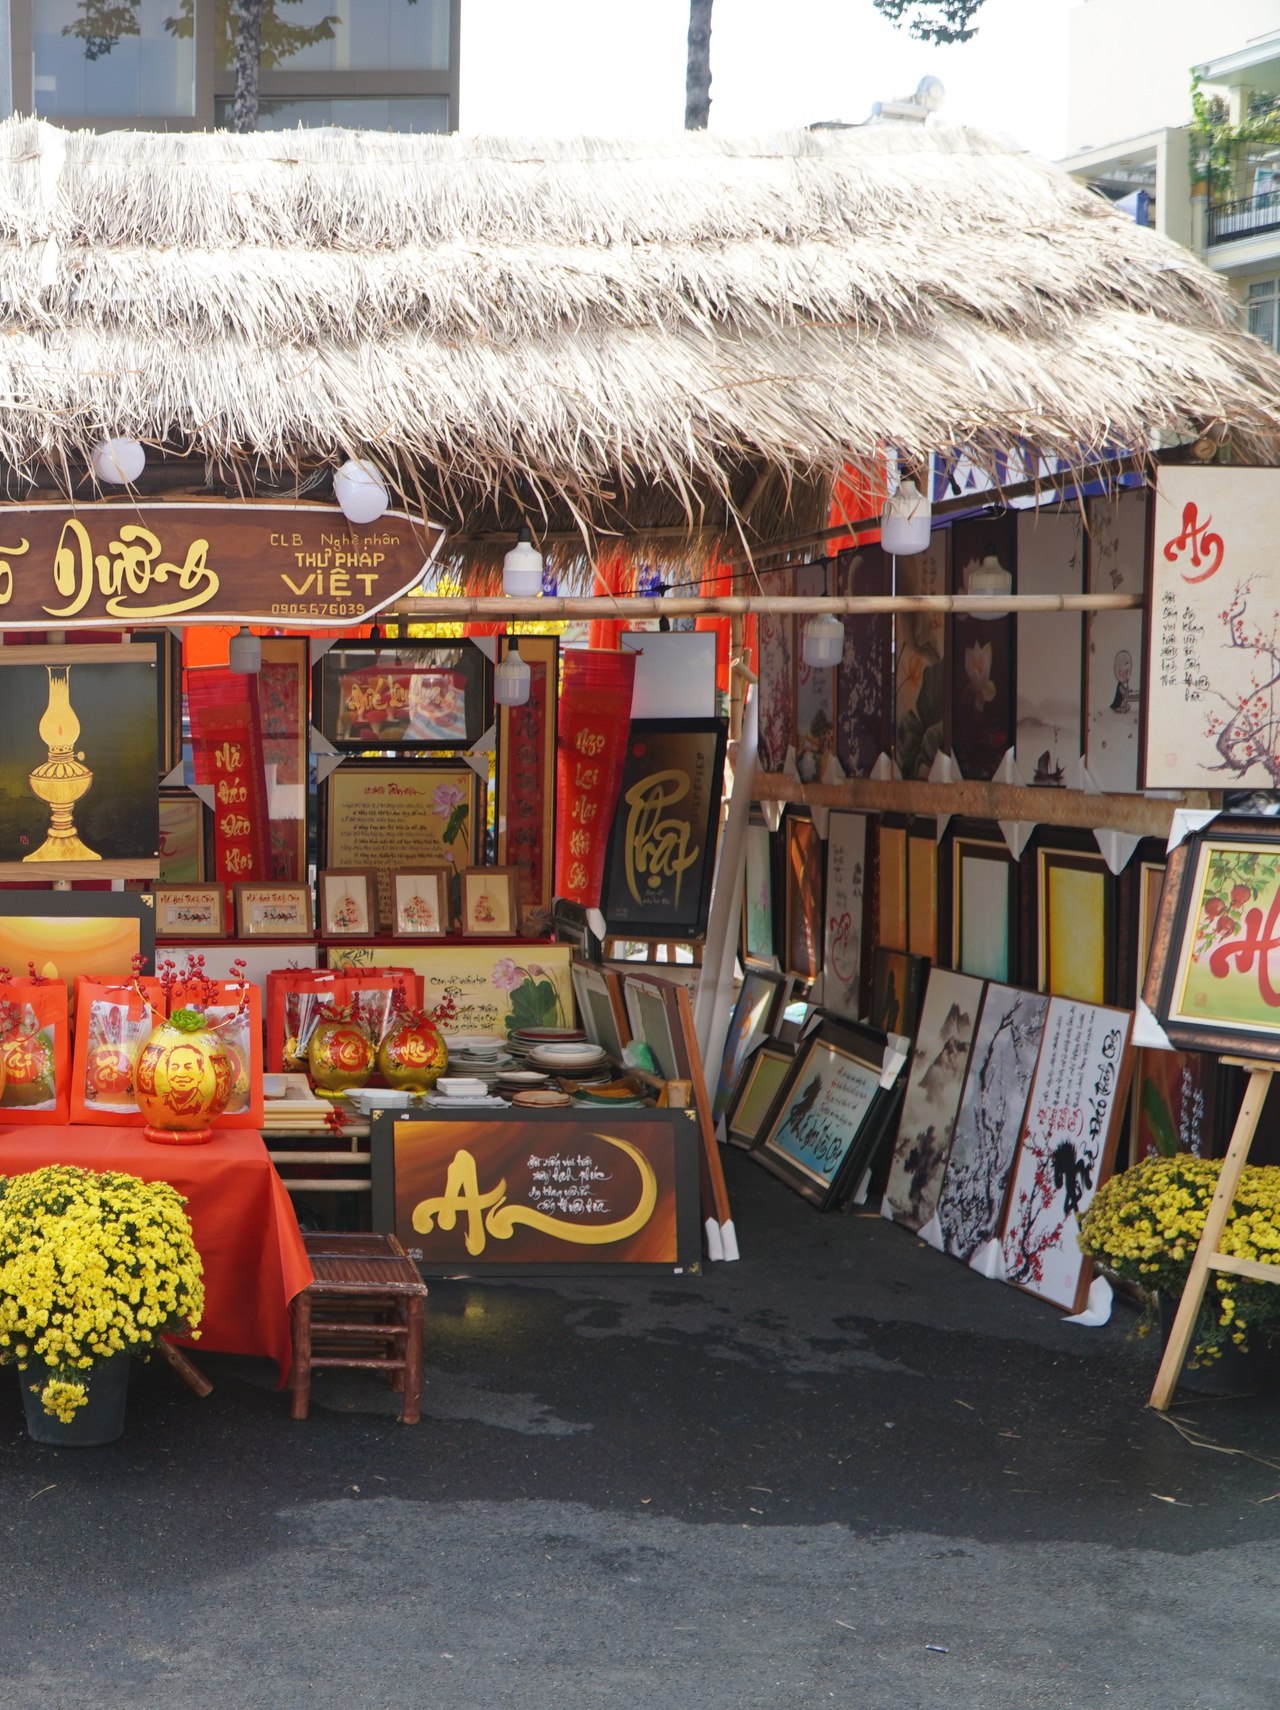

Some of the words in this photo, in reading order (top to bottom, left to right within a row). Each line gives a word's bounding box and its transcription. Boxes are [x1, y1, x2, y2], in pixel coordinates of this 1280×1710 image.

[270, 533, 303, 546] CLB
[364, 533, 400, 546] nhân
[1164, 502, 1224, 584] An
[294, 548, 332, 567] THƯ
[334, 546, 385, 567] PHÁP
[271, 603, 365, 615] 0905676039
